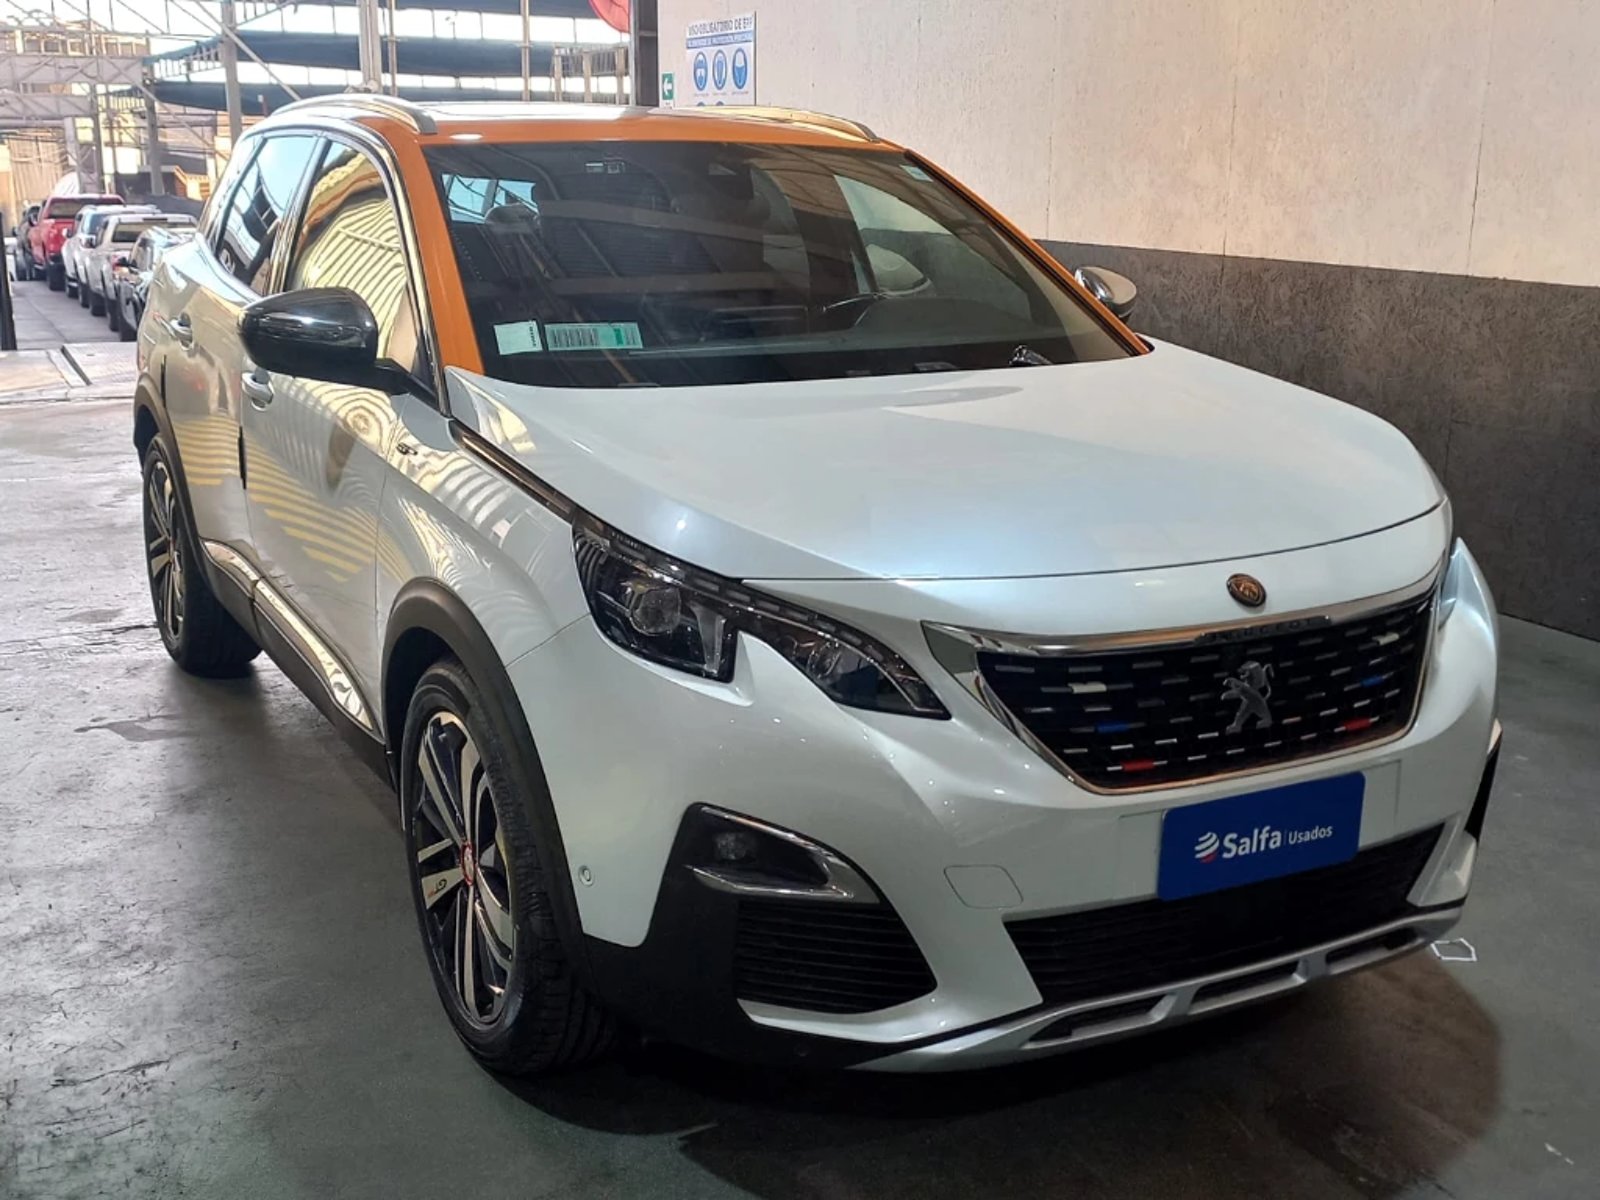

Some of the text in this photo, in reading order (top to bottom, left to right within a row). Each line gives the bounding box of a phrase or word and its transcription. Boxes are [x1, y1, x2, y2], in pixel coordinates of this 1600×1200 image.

[734, 18, 742, 30] DE
[1209, 618, 1313, 642] UGEOT
[1222, 825, 1333, 859] Salfa Usados
